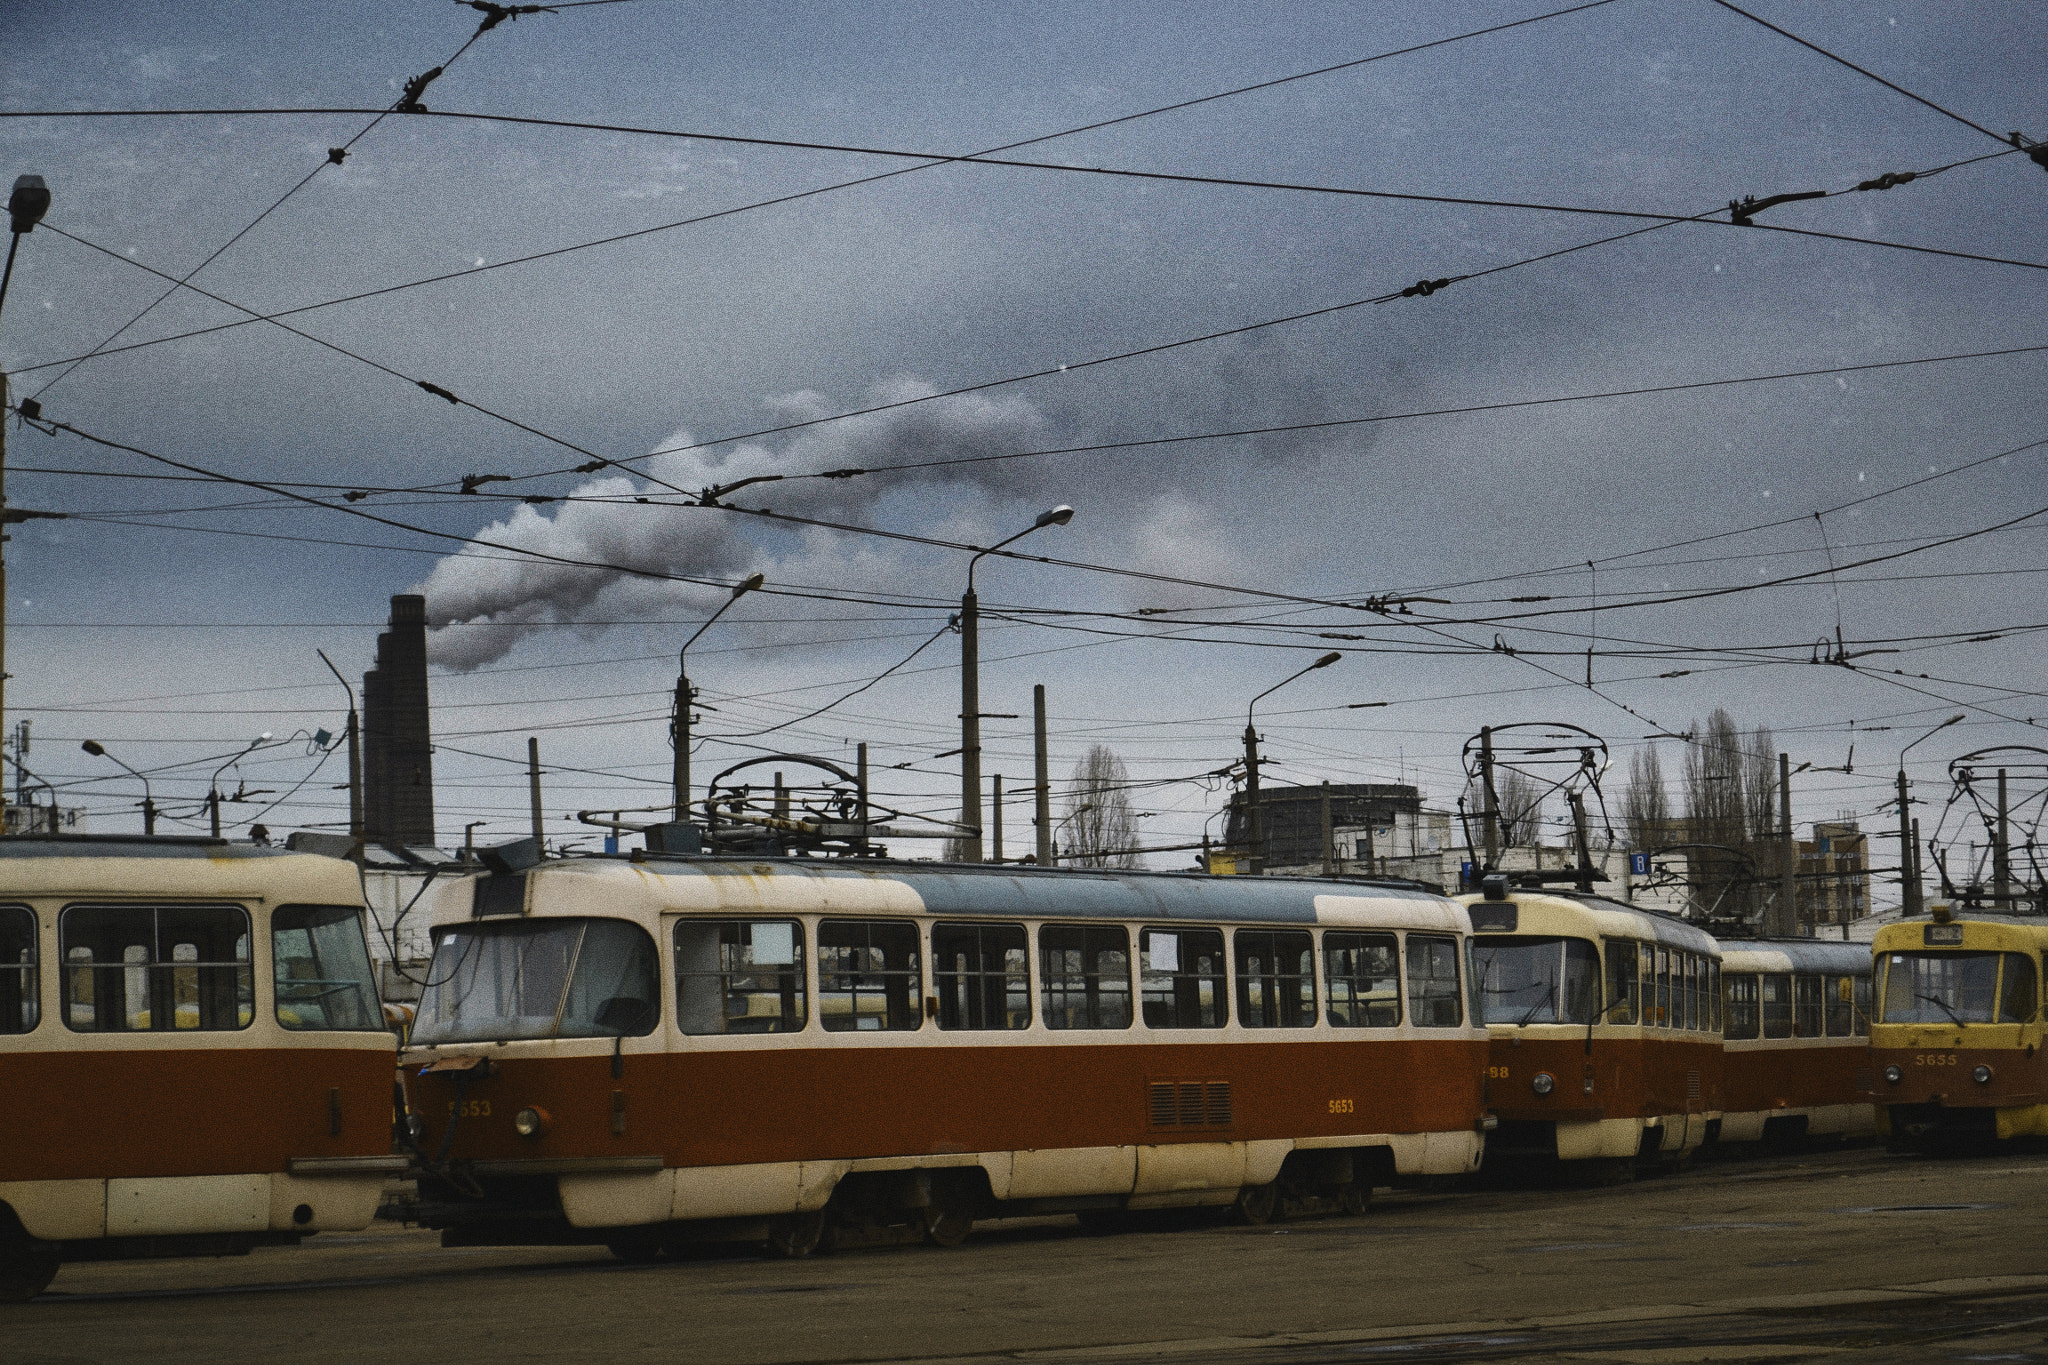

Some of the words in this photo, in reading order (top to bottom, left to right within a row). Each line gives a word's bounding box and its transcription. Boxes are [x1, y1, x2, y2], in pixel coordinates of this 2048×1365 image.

[1637, 855, 1645, 872] 8
[1916, 1054, 1957, 1066] 5655
[1329, 1100, 1354, 1114] 5653
